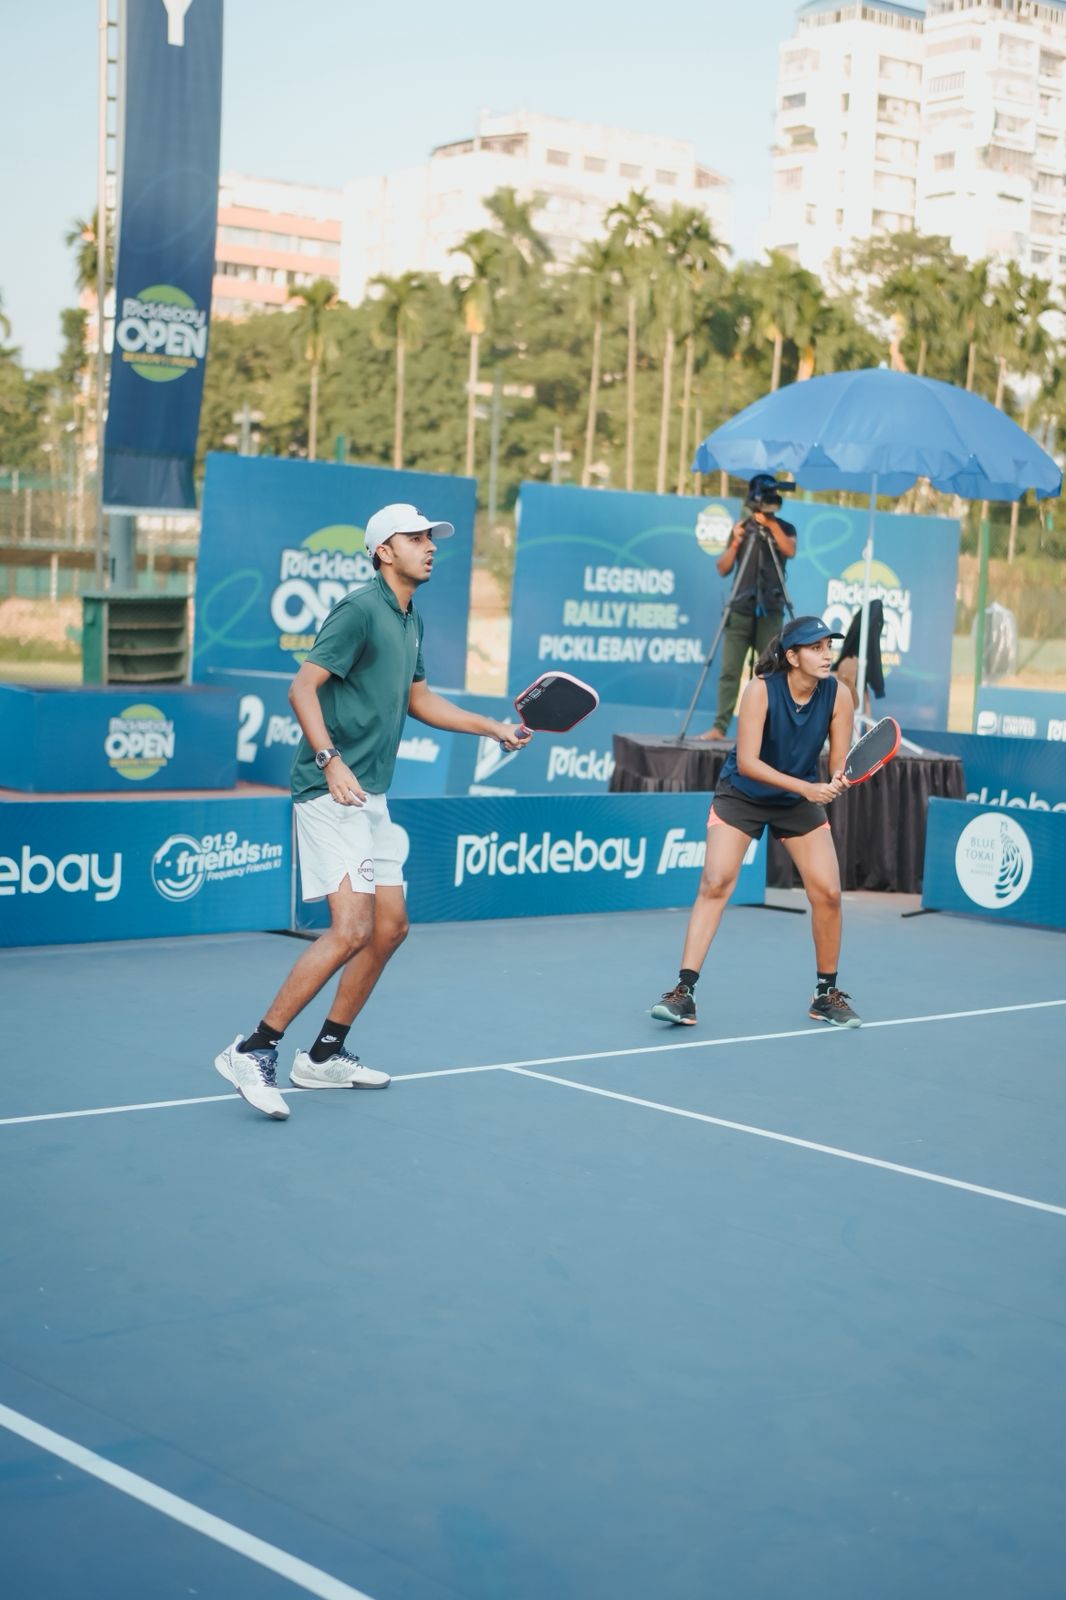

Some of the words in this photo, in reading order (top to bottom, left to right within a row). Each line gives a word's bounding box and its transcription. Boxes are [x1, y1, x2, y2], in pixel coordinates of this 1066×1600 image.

[116, 318, 208, 358] OPEN
[281, 549, 376, 581] Pickleb
[584, 566, 675, 595] LEGENDS
[563, 600, 627, 628] RALLY
[538, 635, 649, 662] PICKLEBAY
[648, 637, 706, 664] OPEN.
[236, 694, 264, 763] 2
[104, 732, 175, 759] OPEN
[201, 831, 238, 853] 91.9
[965, 848, 994, 862] TOKAI
[970, 837, 996, 849] BLUE
[177, 840, 260, 876] friends
[262, 842, 283, 859] fm
[454, 831, 647, 887] Picklebay
